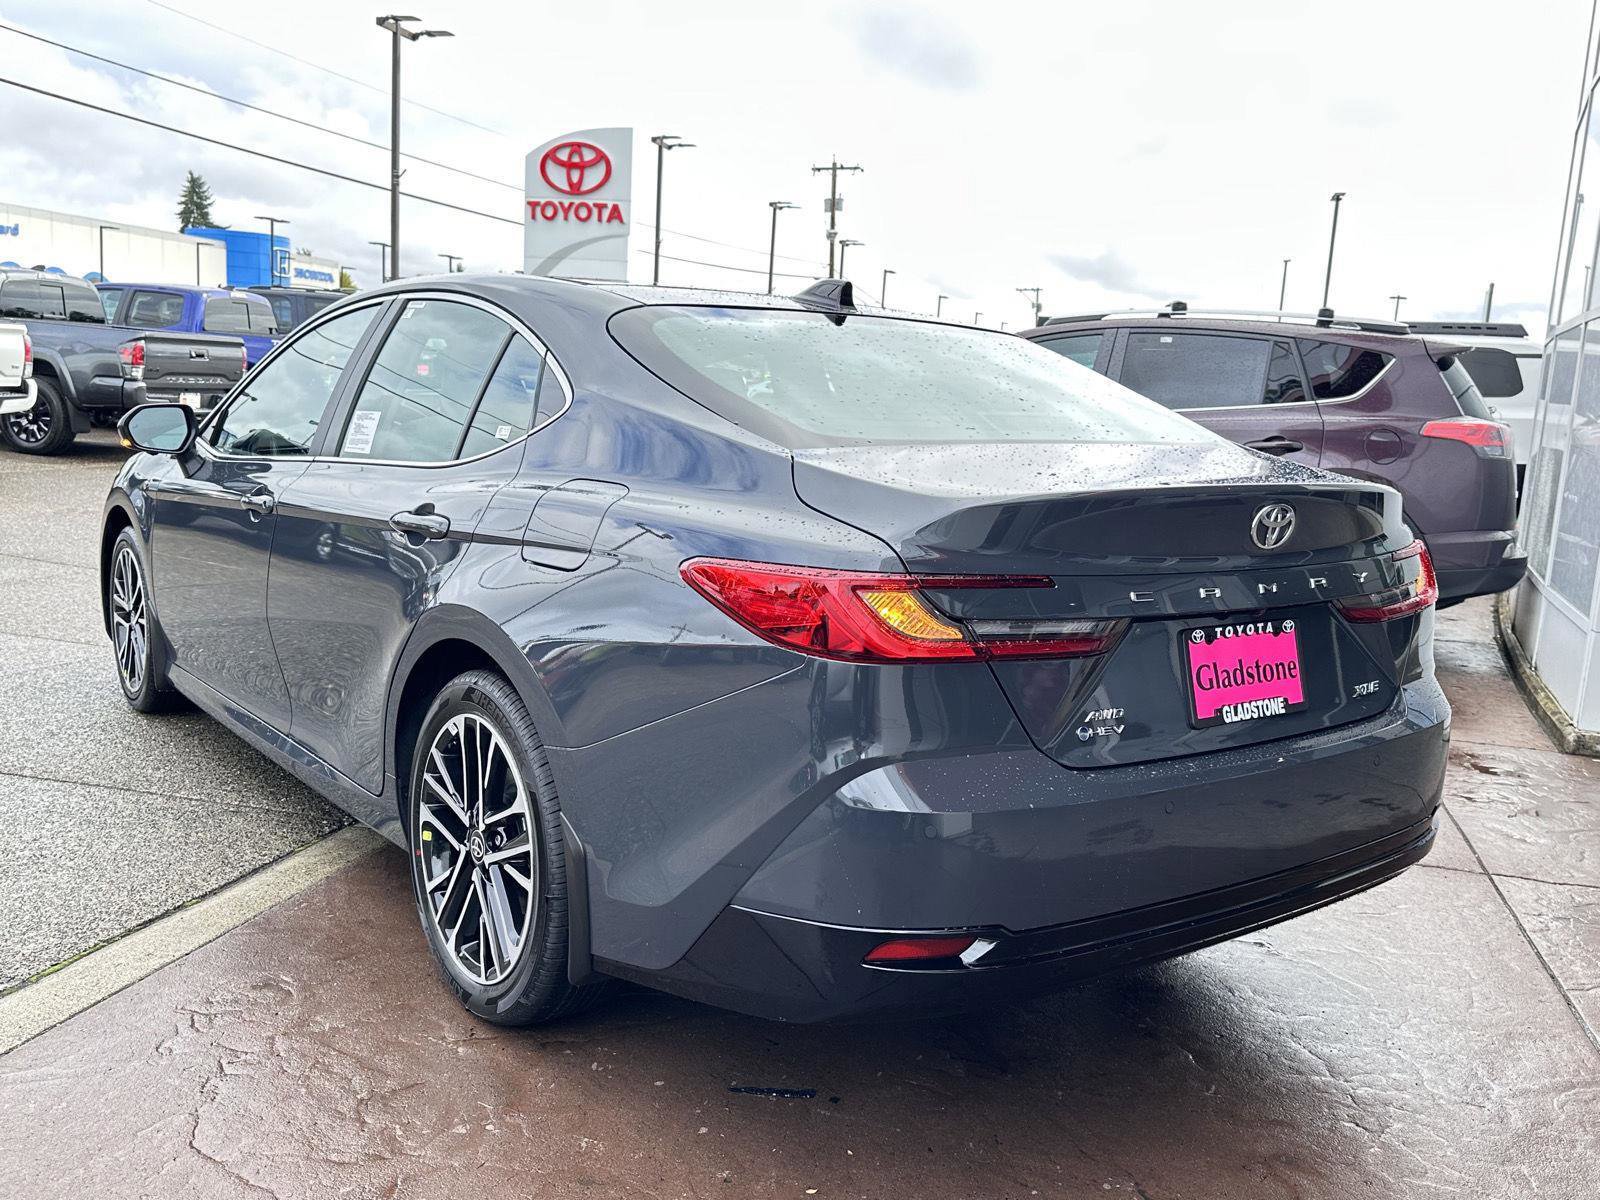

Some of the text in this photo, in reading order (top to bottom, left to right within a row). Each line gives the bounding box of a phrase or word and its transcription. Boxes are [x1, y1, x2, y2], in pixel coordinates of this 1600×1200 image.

[527, 201, 625, 224] TOYOTA
[1130, 571, 1369, 602] CAMRY
[1215, 622, 1274, 639] TOYOTA
[1195, 659, 1298, 691] Gladstone
[1222, 697, 1286, 723] GLADSTONE
